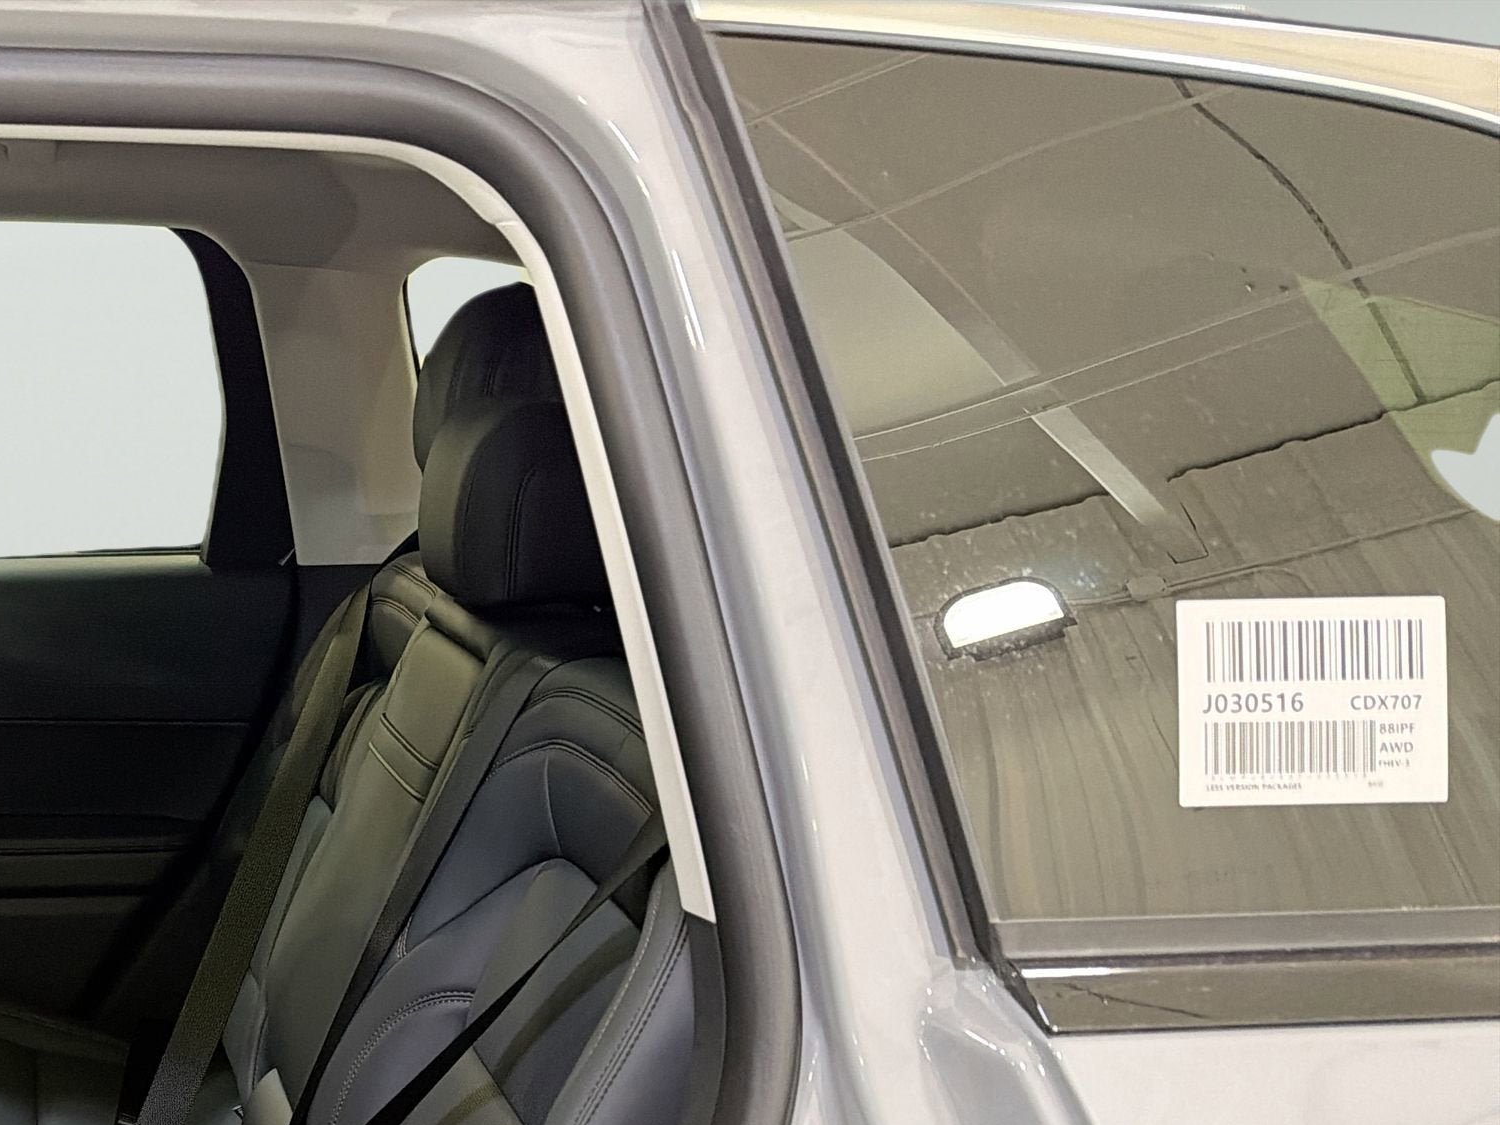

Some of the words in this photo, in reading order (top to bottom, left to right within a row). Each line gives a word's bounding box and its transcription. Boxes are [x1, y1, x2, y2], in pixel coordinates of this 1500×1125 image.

[1202, 692, 1304, 714] J030516
[1350, 694, 1423, 711] CDX707
[1380, 741, 1414, 753] AWD
